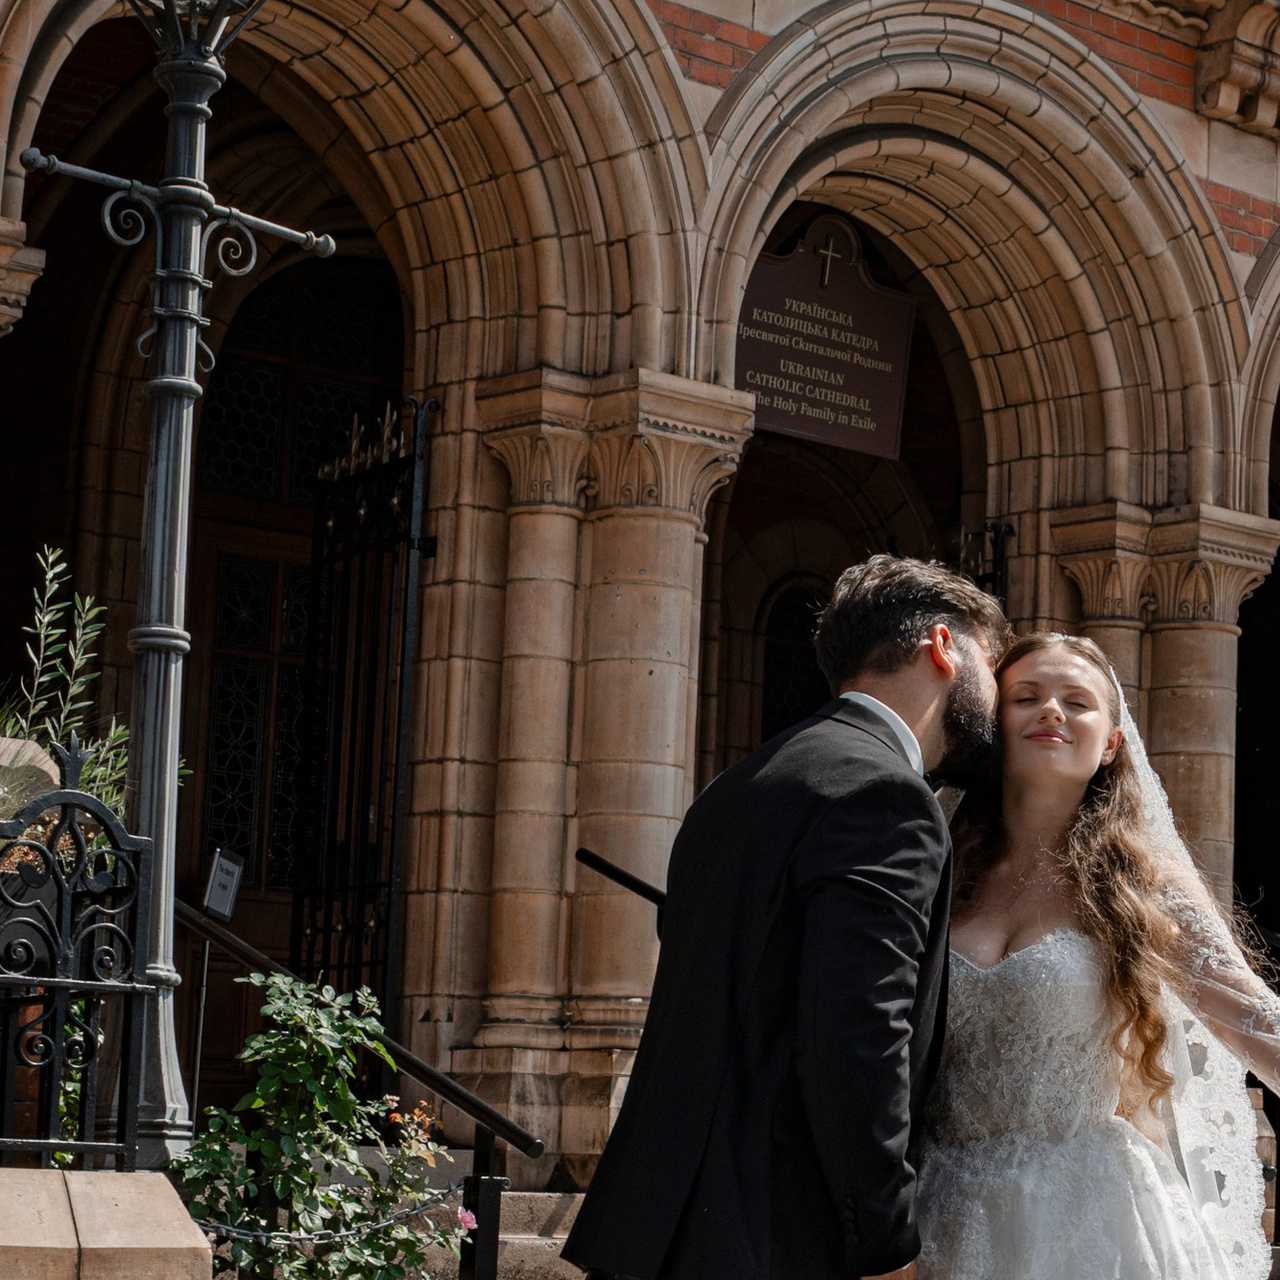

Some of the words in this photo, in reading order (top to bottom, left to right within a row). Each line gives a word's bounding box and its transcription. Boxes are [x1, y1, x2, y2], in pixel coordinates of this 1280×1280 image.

[785, 298, 854, 327] УКРАЇНСЬКА
[753, 308, 828, 338] КАТОЛИЦЬКА
[831, 328, 880, 351] КАТЕДРА
[780, 359, 845, 386] UKRAINIAN
[853, 352, 893, 372] Родини
[746, 370, 804, 395] CATHOLIC
[805, 385, 872, 412] CATHEDRAL
[773, 395, 799, 415] Holy
[800, 402, 837, 425] Family
[838, 410, 849, 425] in
[851, 414, 877, 431] Exile
